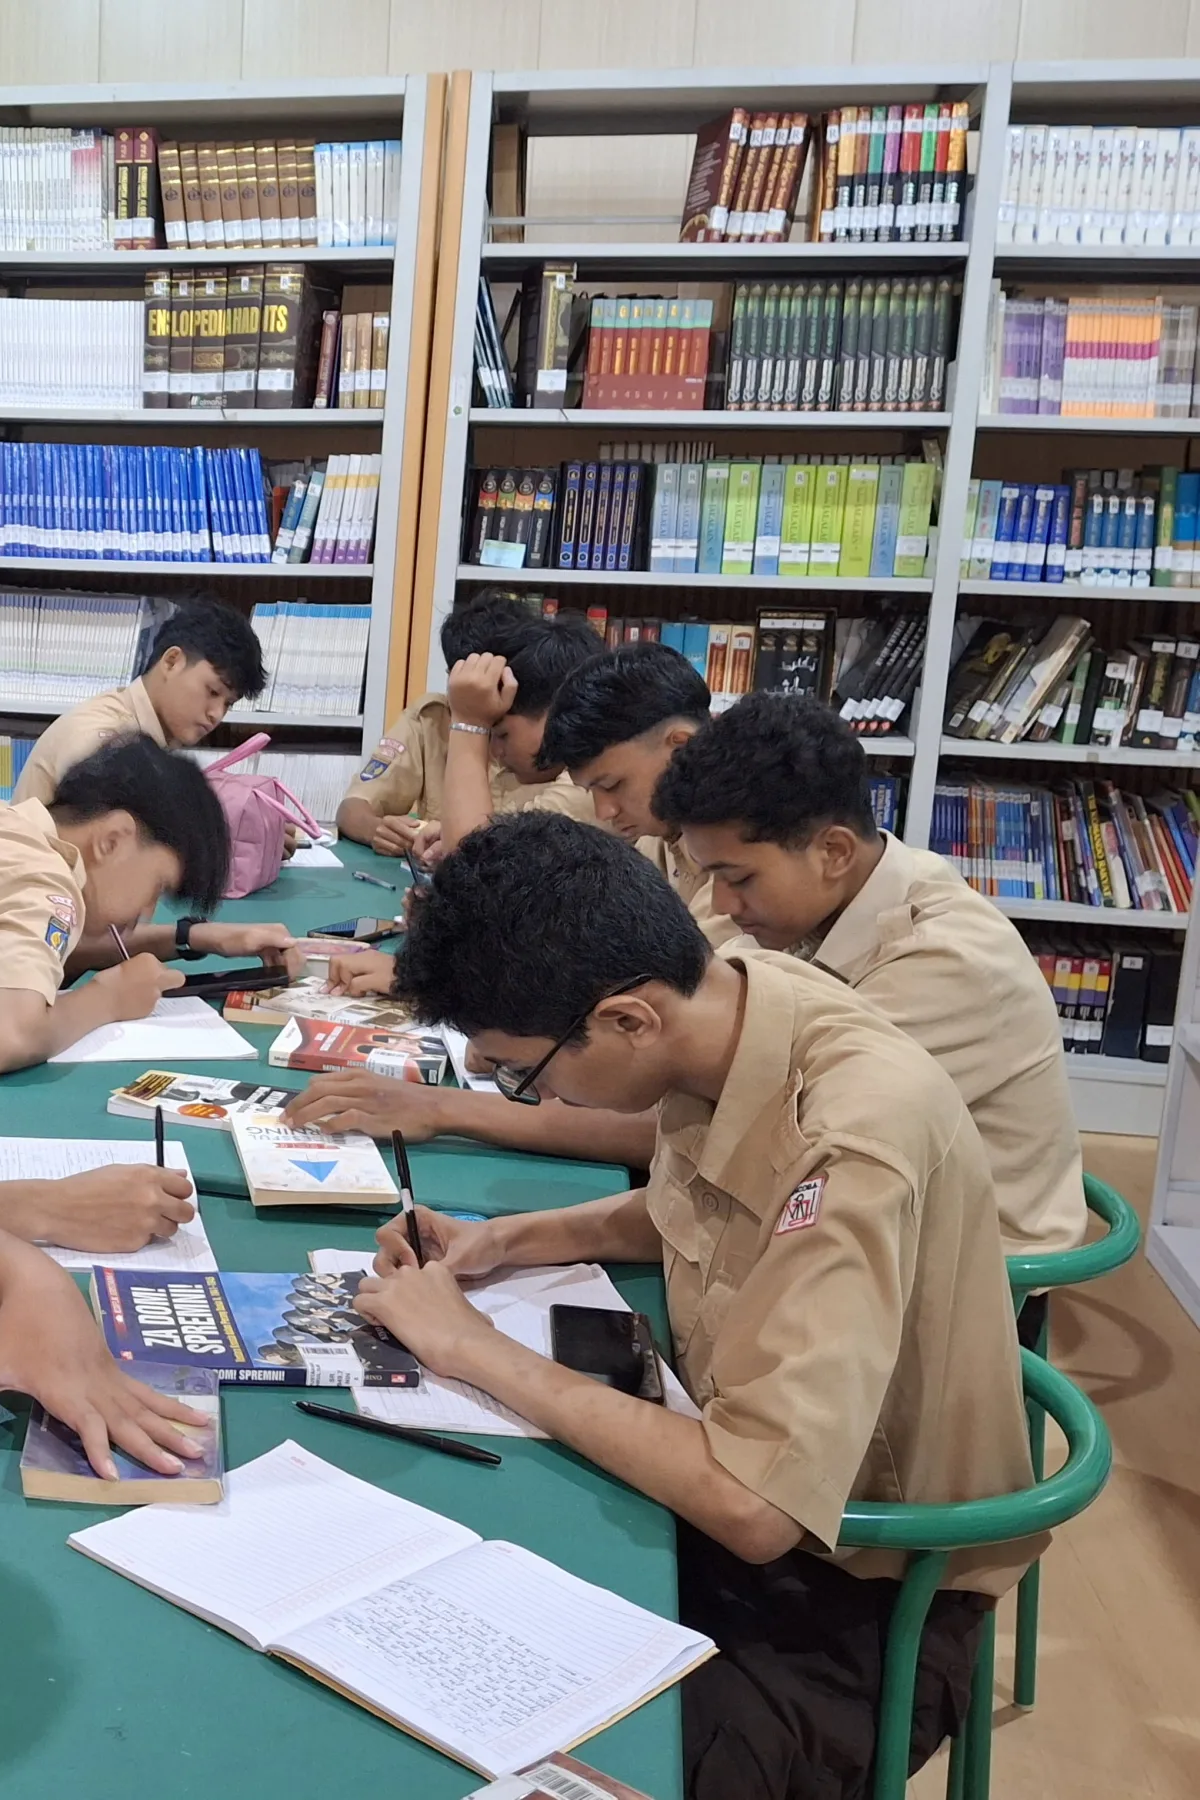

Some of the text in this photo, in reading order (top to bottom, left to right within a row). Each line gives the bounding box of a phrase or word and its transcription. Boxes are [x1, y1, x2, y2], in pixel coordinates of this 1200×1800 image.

[246, 1126, 321, 1135] RNING
[130, 1286, 184, 1348] ZA DOM!
[167, 1283, 226, 1355] SPREMNI!
[239, 1369, 285, 1382] SPREMNI!
